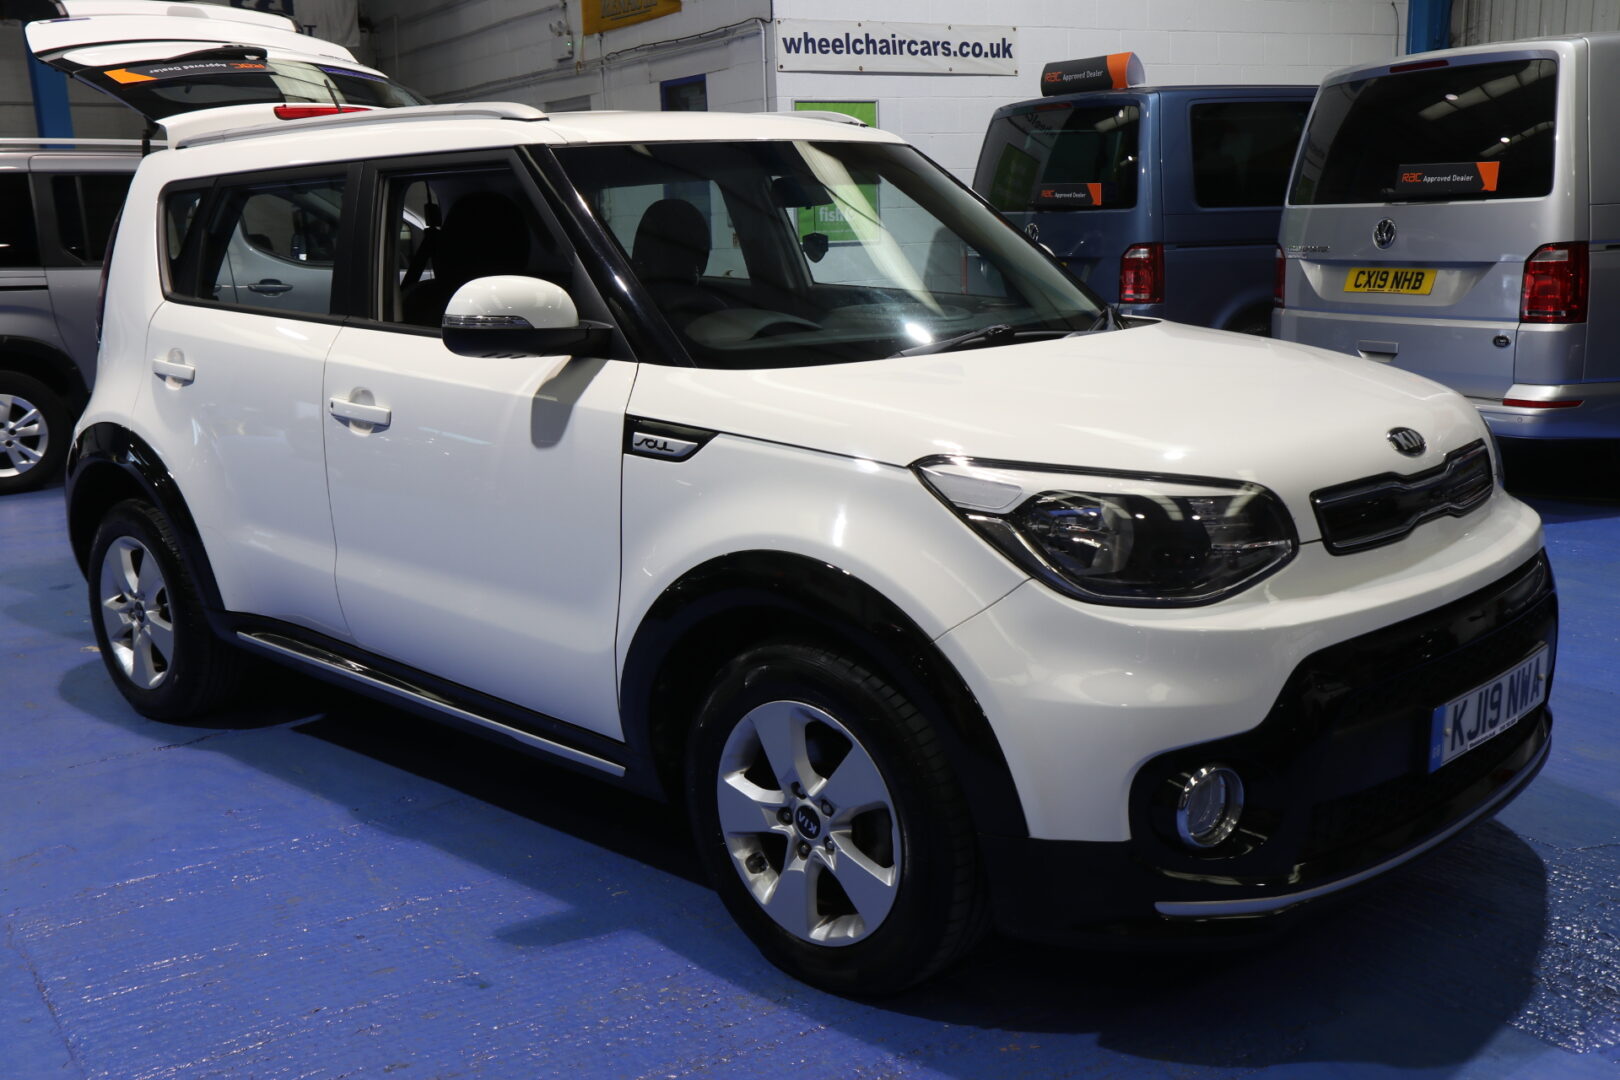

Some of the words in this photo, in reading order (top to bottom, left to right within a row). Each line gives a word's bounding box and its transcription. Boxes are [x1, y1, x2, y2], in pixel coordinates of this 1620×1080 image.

[782, 31, 1014, 59] wheelchaircars.co.uk
[149, 66, 182, 74] Dealer
[1063, 71, 1086, 82] Approved
[1086, 69, 1104, 78] Dealer
[1423, 174, 1451, 184] Approved
[1452, 173, 1474, 182] Dealer
[1055, 191, 1072, 199] Approved
[1354, 270, 1389, 289] CX19
[1390, 271, 1425, 290] NHB
[1451, 682, 1503, 751] KJ19
[1507, 657, 1541, 719] NWA
